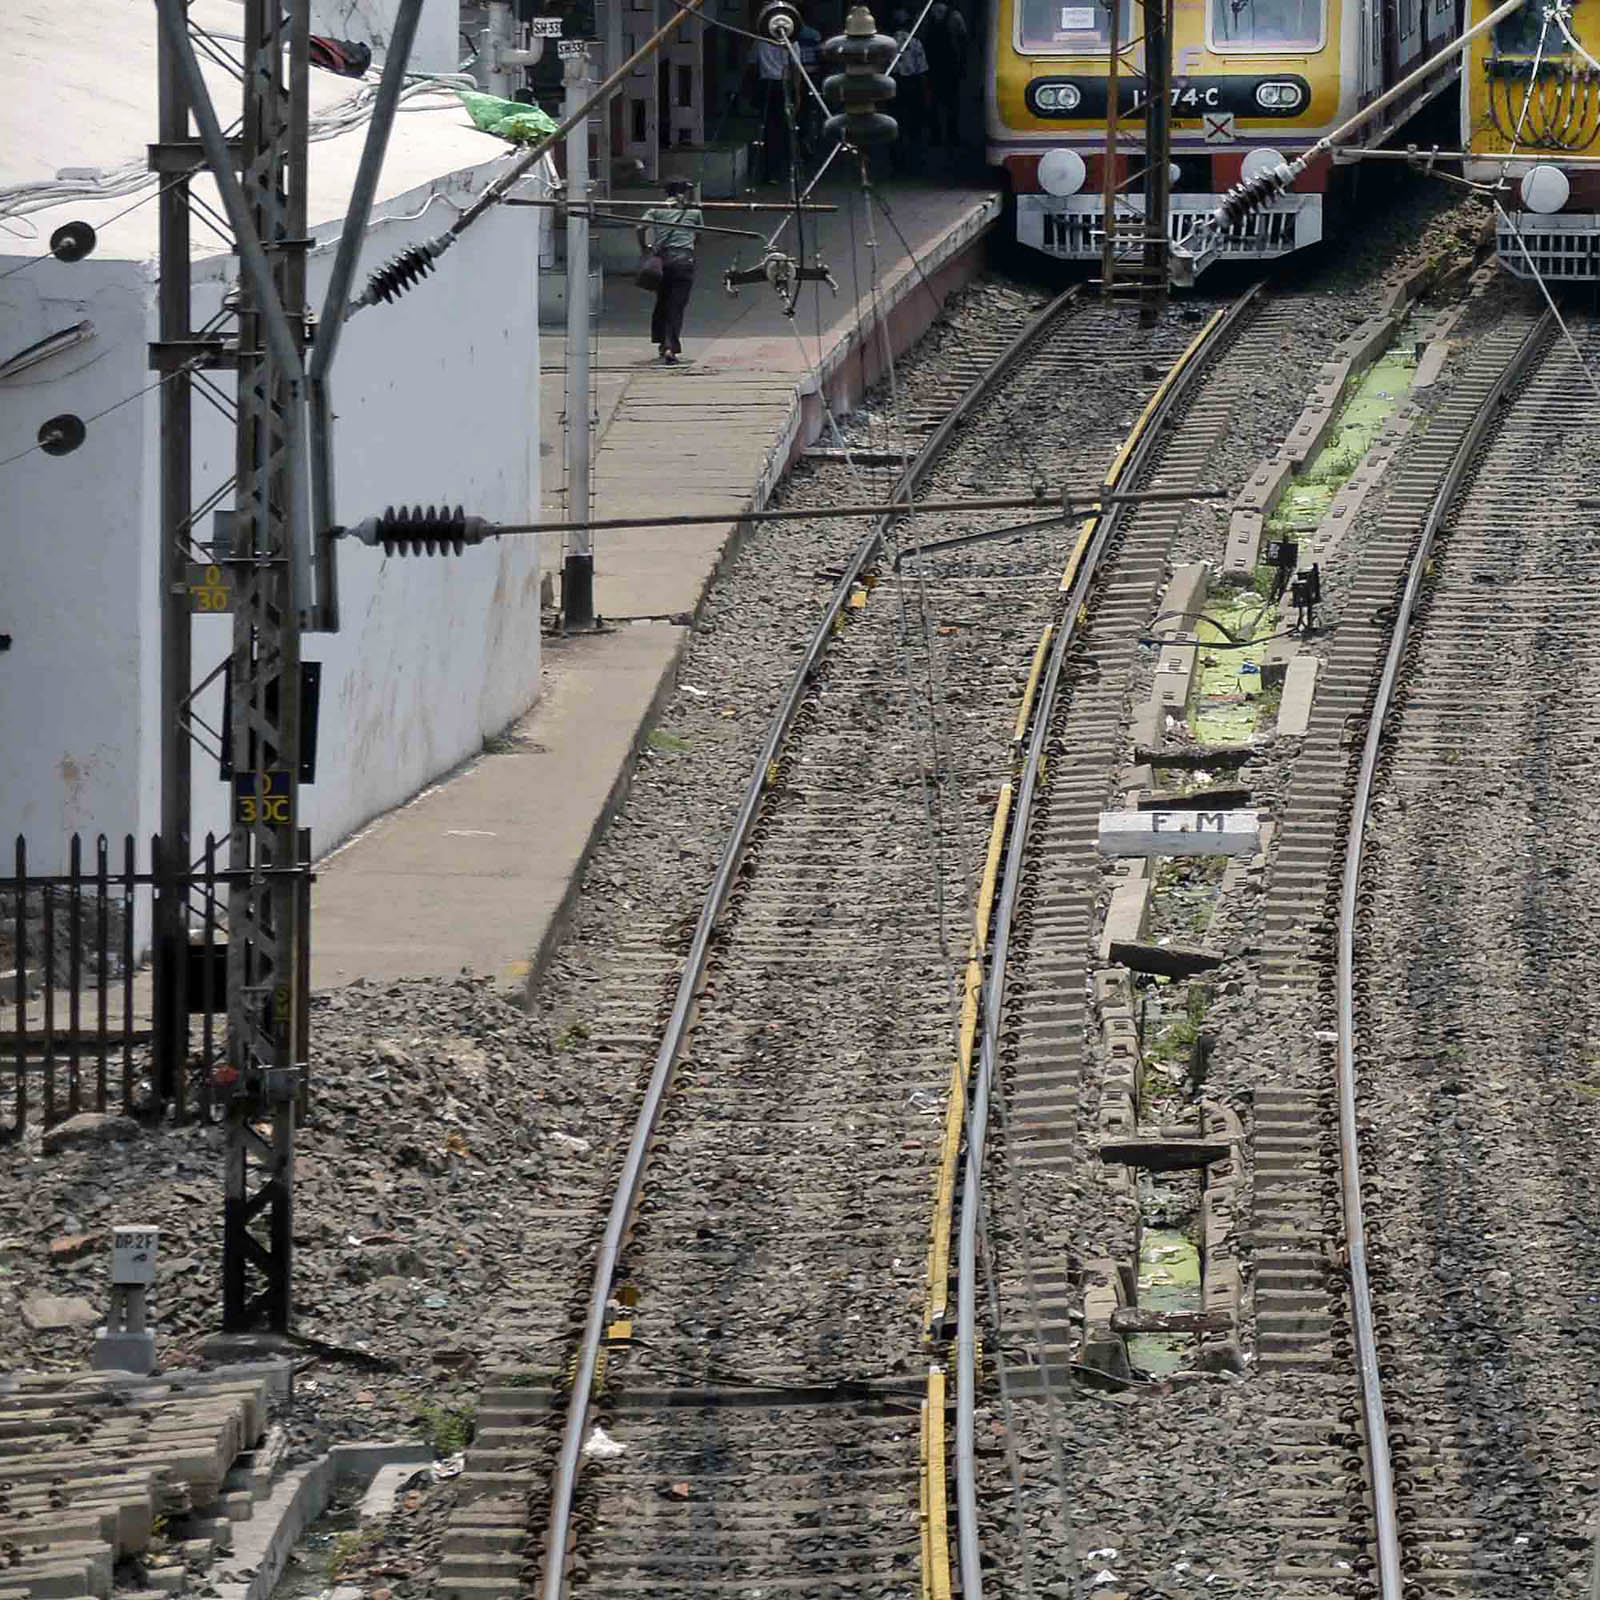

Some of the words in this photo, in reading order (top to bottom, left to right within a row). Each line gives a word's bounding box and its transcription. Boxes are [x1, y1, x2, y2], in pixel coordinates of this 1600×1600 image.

[1133, 87, 1219, 108] 174-C
[205, 565, 221, 585] 0
[197, 589, 228, 611] 30
